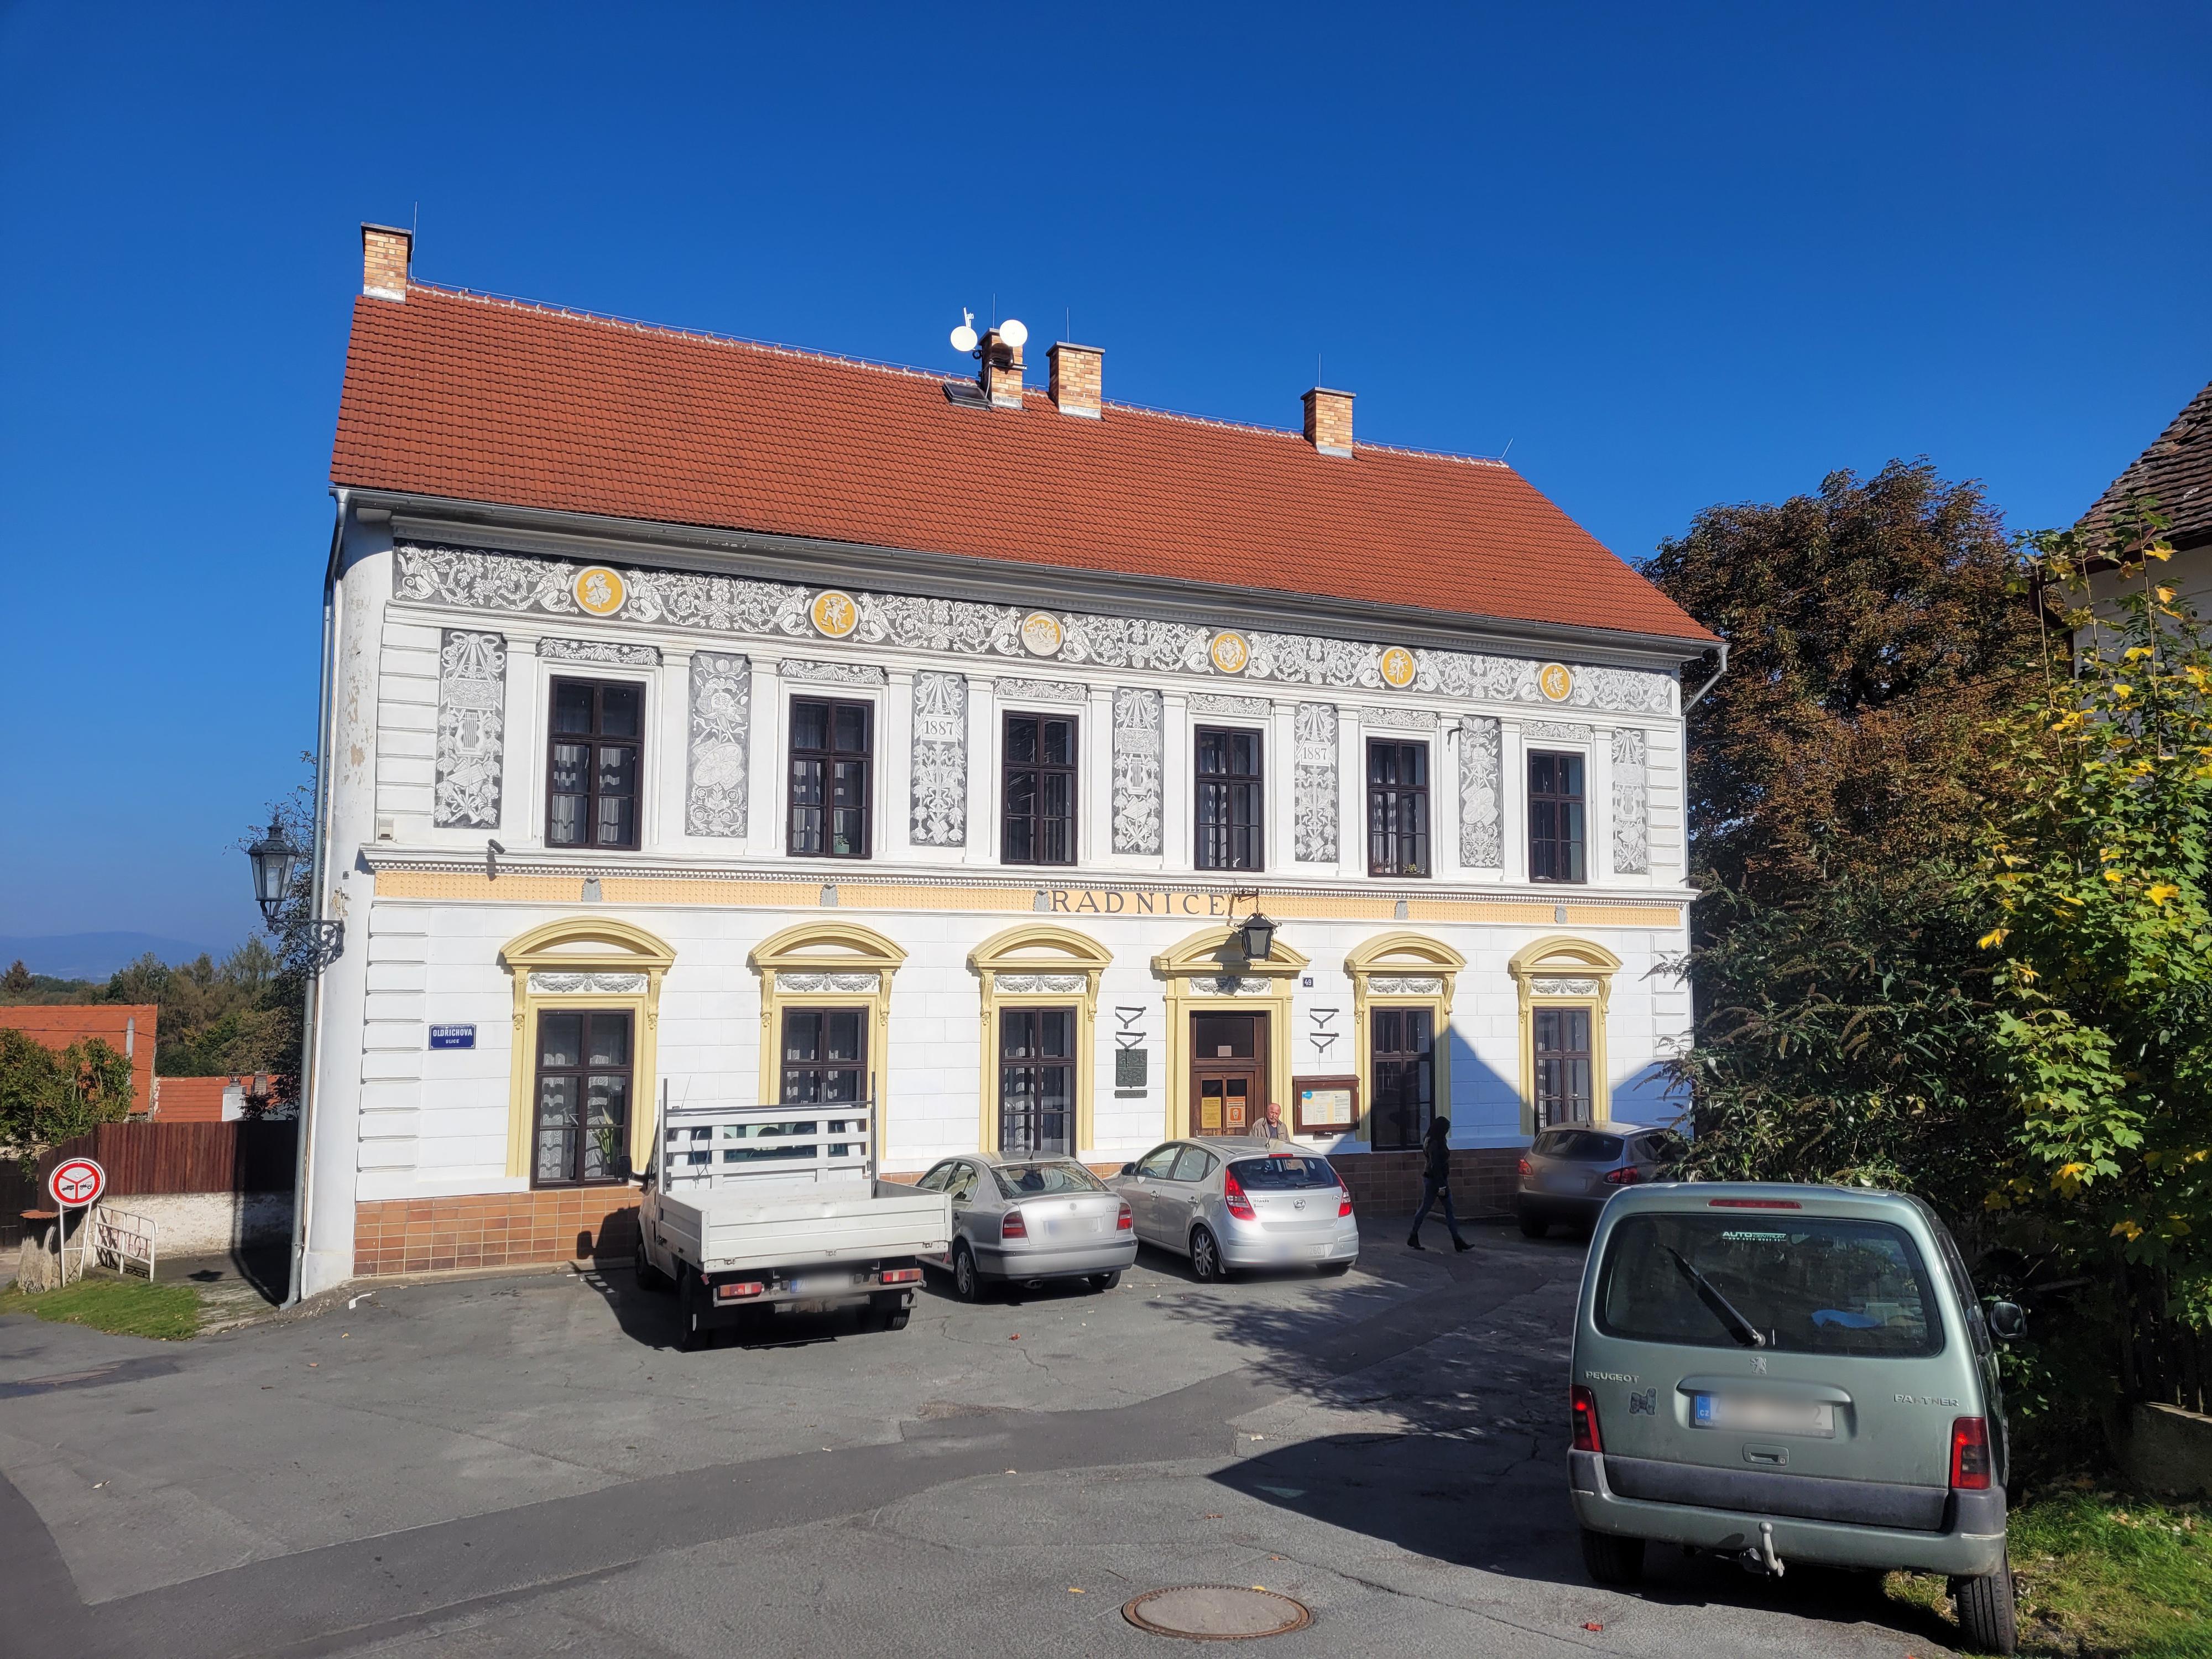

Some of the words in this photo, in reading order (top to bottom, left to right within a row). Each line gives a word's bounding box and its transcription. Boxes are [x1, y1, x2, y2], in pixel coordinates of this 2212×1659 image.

[923, 720, 954, 735] 1887
[1302, 747, 1327, 760] 1887
[1051, 890, 1225, 916] RADNICE
[432, 1026, 473, 1037] OLDŘICHOVA
[1585, 1371, 1639, 1383] PEUGEOT
[1893, 1394, 1959, 1406] PARTNER
